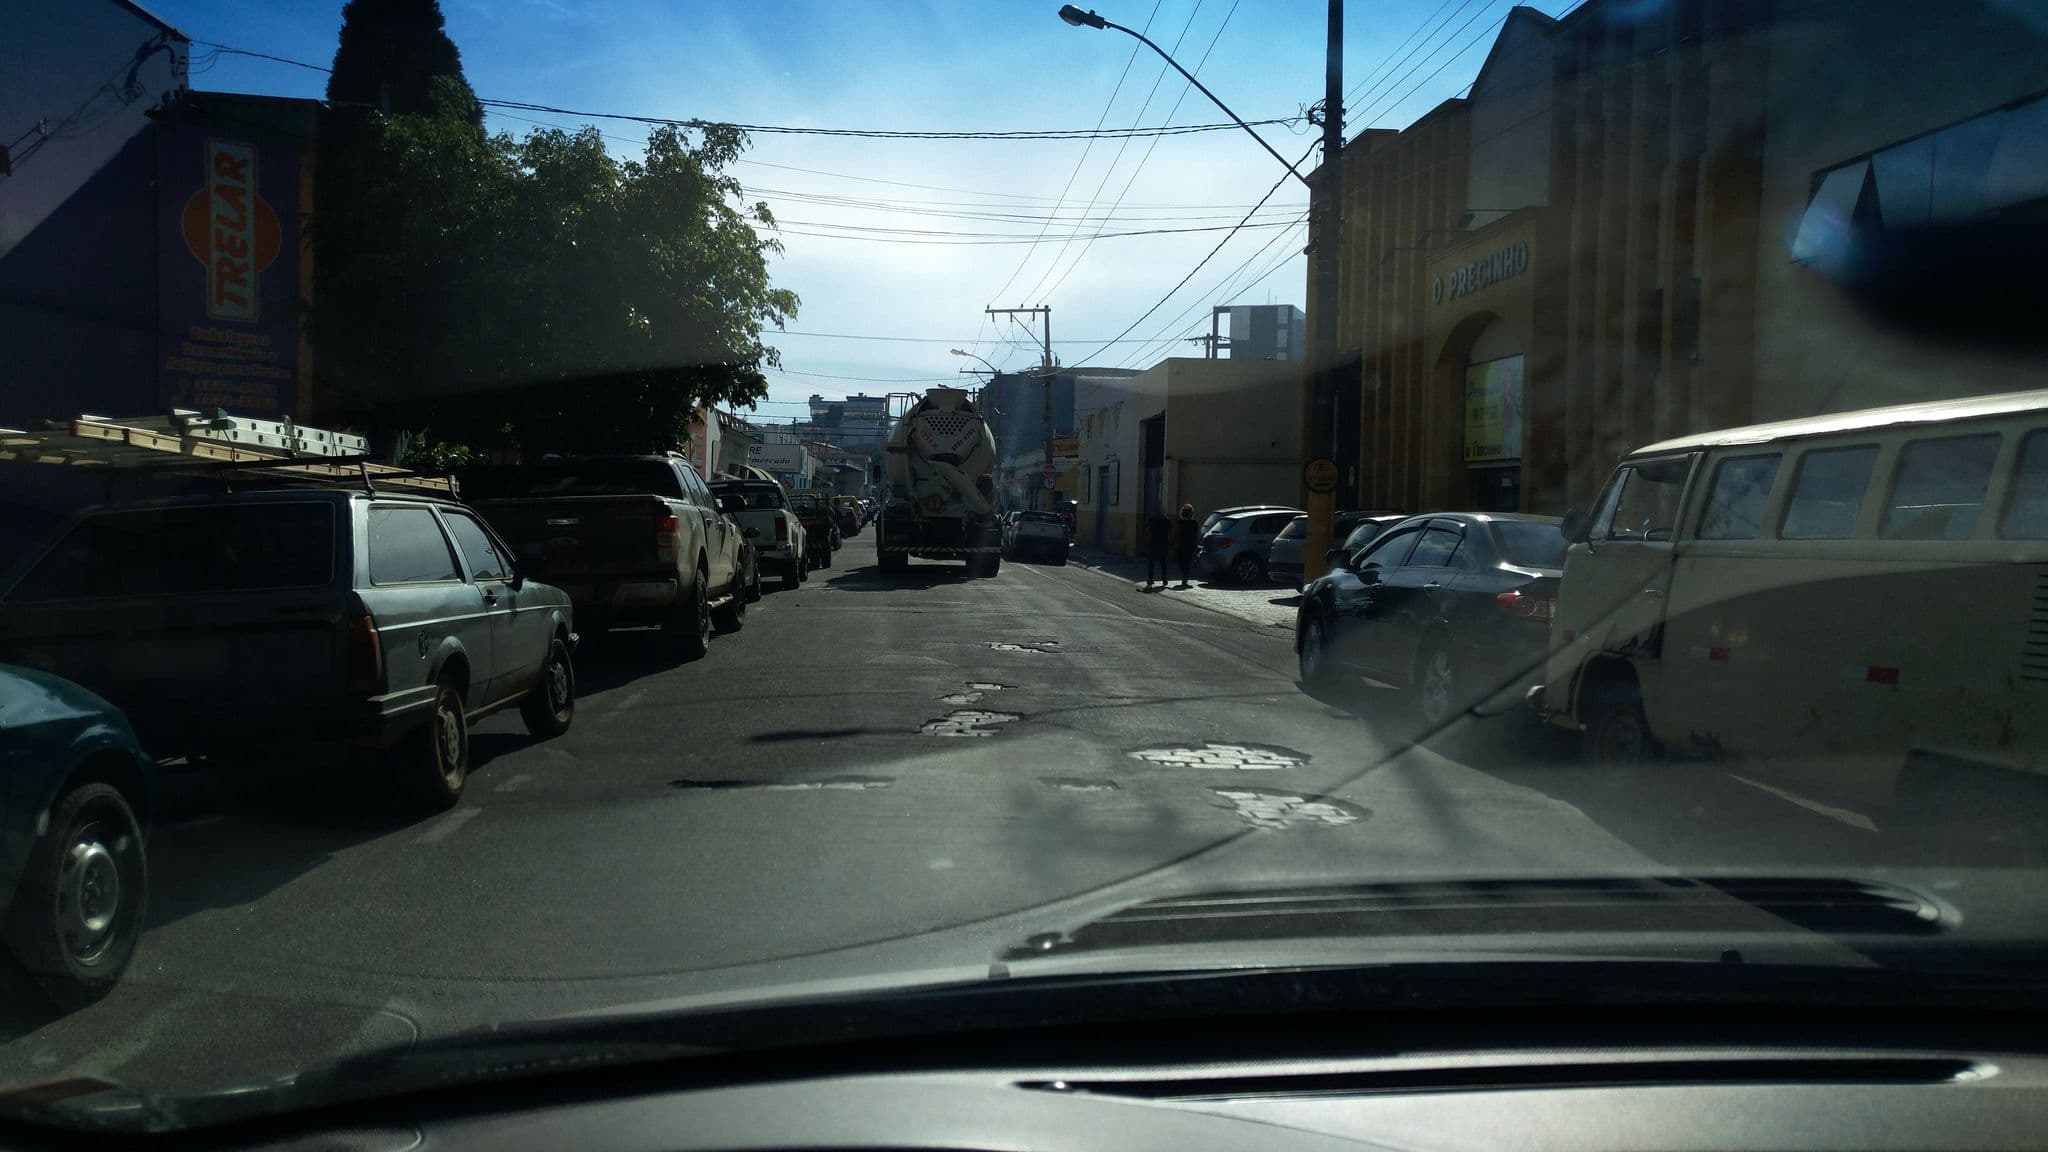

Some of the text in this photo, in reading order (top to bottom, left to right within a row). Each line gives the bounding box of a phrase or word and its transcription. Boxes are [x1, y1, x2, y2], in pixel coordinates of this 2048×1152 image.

[214, 151, 249, 309] TRELAR
[1432, 241, 1529, 305] O PRECINHO
[749, 446, 763, 455] RE
